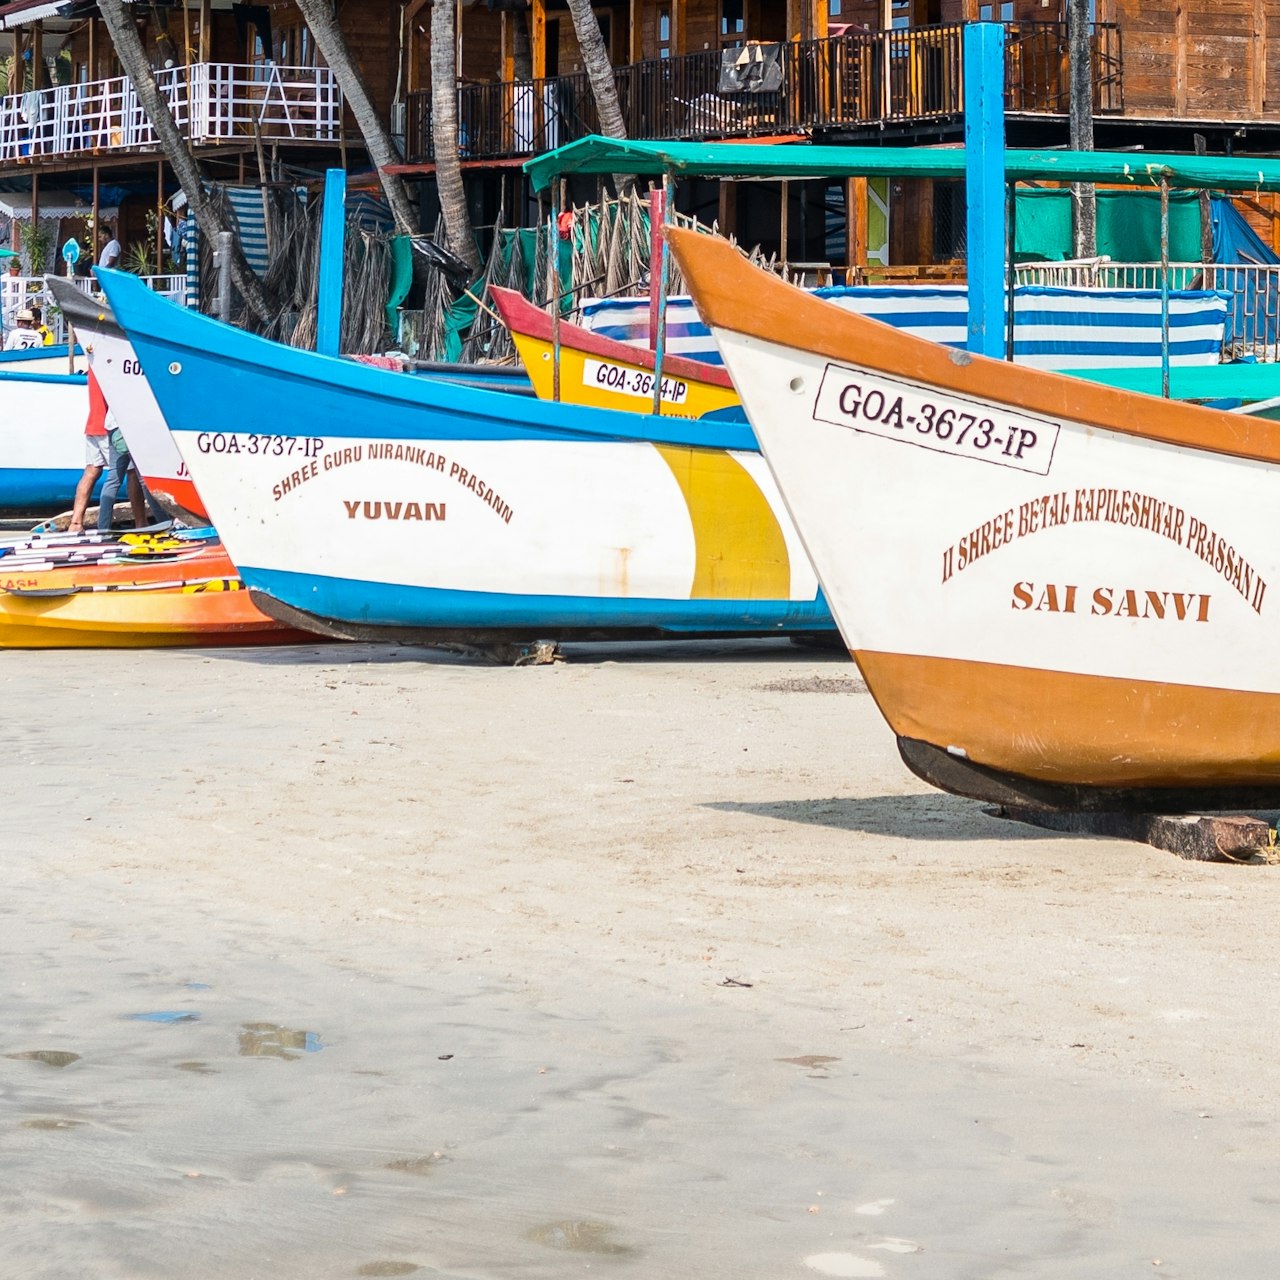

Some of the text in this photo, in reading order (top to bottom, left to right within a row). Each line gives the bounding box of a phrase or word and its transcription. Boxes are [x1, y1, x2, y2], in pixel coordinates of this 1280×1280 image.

[197, 432, 324, 458] GOA-3737-IP
[838, 384, 1038, 459] GOA-3673-IP
[272, 442, 514, 525] SHREE GURU NIRANKAR PRASANN
[343, 500, 447, 521] YUVAN
[958, 508, 1014, 572] SHREE
[1018, 492, 1070, 538] BETAL
[1072, 488, 1185, 546] KAPILESHWAR
[1186, 516, 1254, 600] PRASSAN
[1011, 581, 1212, 622] SAI SANVI
